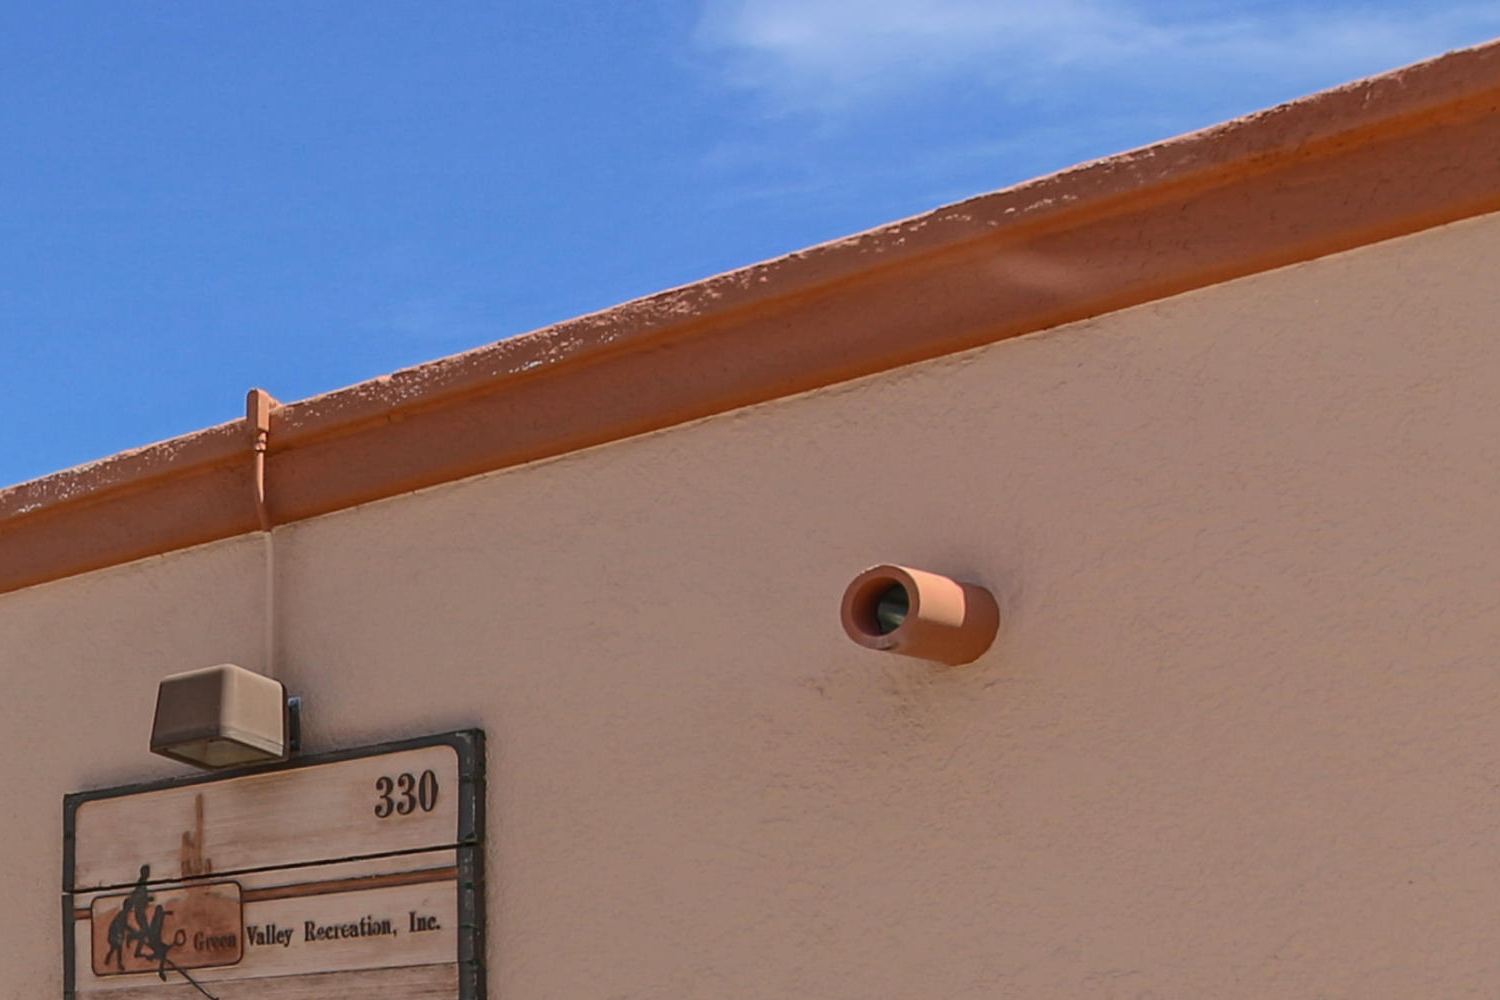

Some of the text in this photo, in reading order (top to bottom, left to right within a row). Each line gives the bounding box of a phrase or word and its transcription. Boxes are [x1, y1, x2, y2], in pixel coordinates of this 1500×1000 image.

[374, 769, 438, 818] 330
[193, 911, 441, 951] Green Valley Recreation, Inc.
